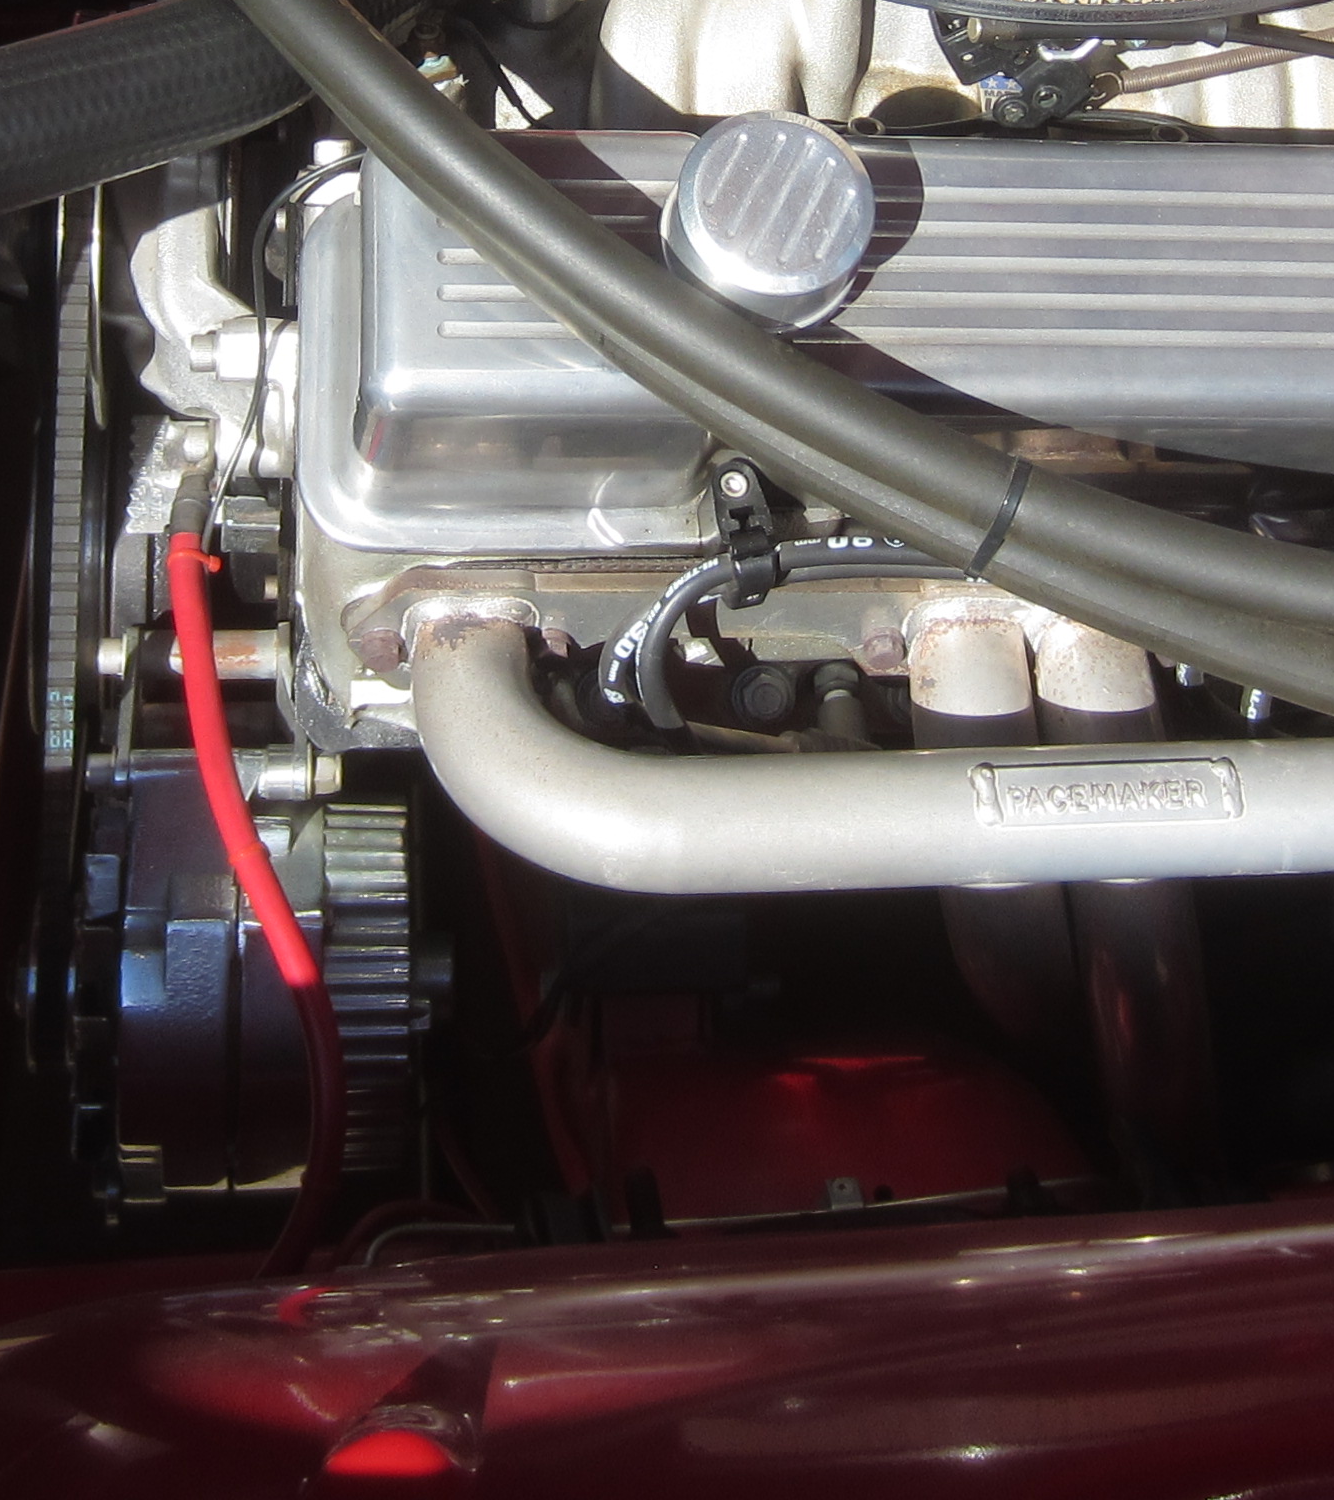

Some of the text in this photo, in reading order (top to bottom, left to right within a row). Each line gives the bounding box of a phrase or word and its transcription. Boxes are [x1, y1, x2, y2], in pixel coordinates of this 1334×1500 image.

[665, 558, 718, 598] HI-TEMP
[608, 660, 620, 682] mm
[1005, 777, 1208, 817] PACEMAKER
